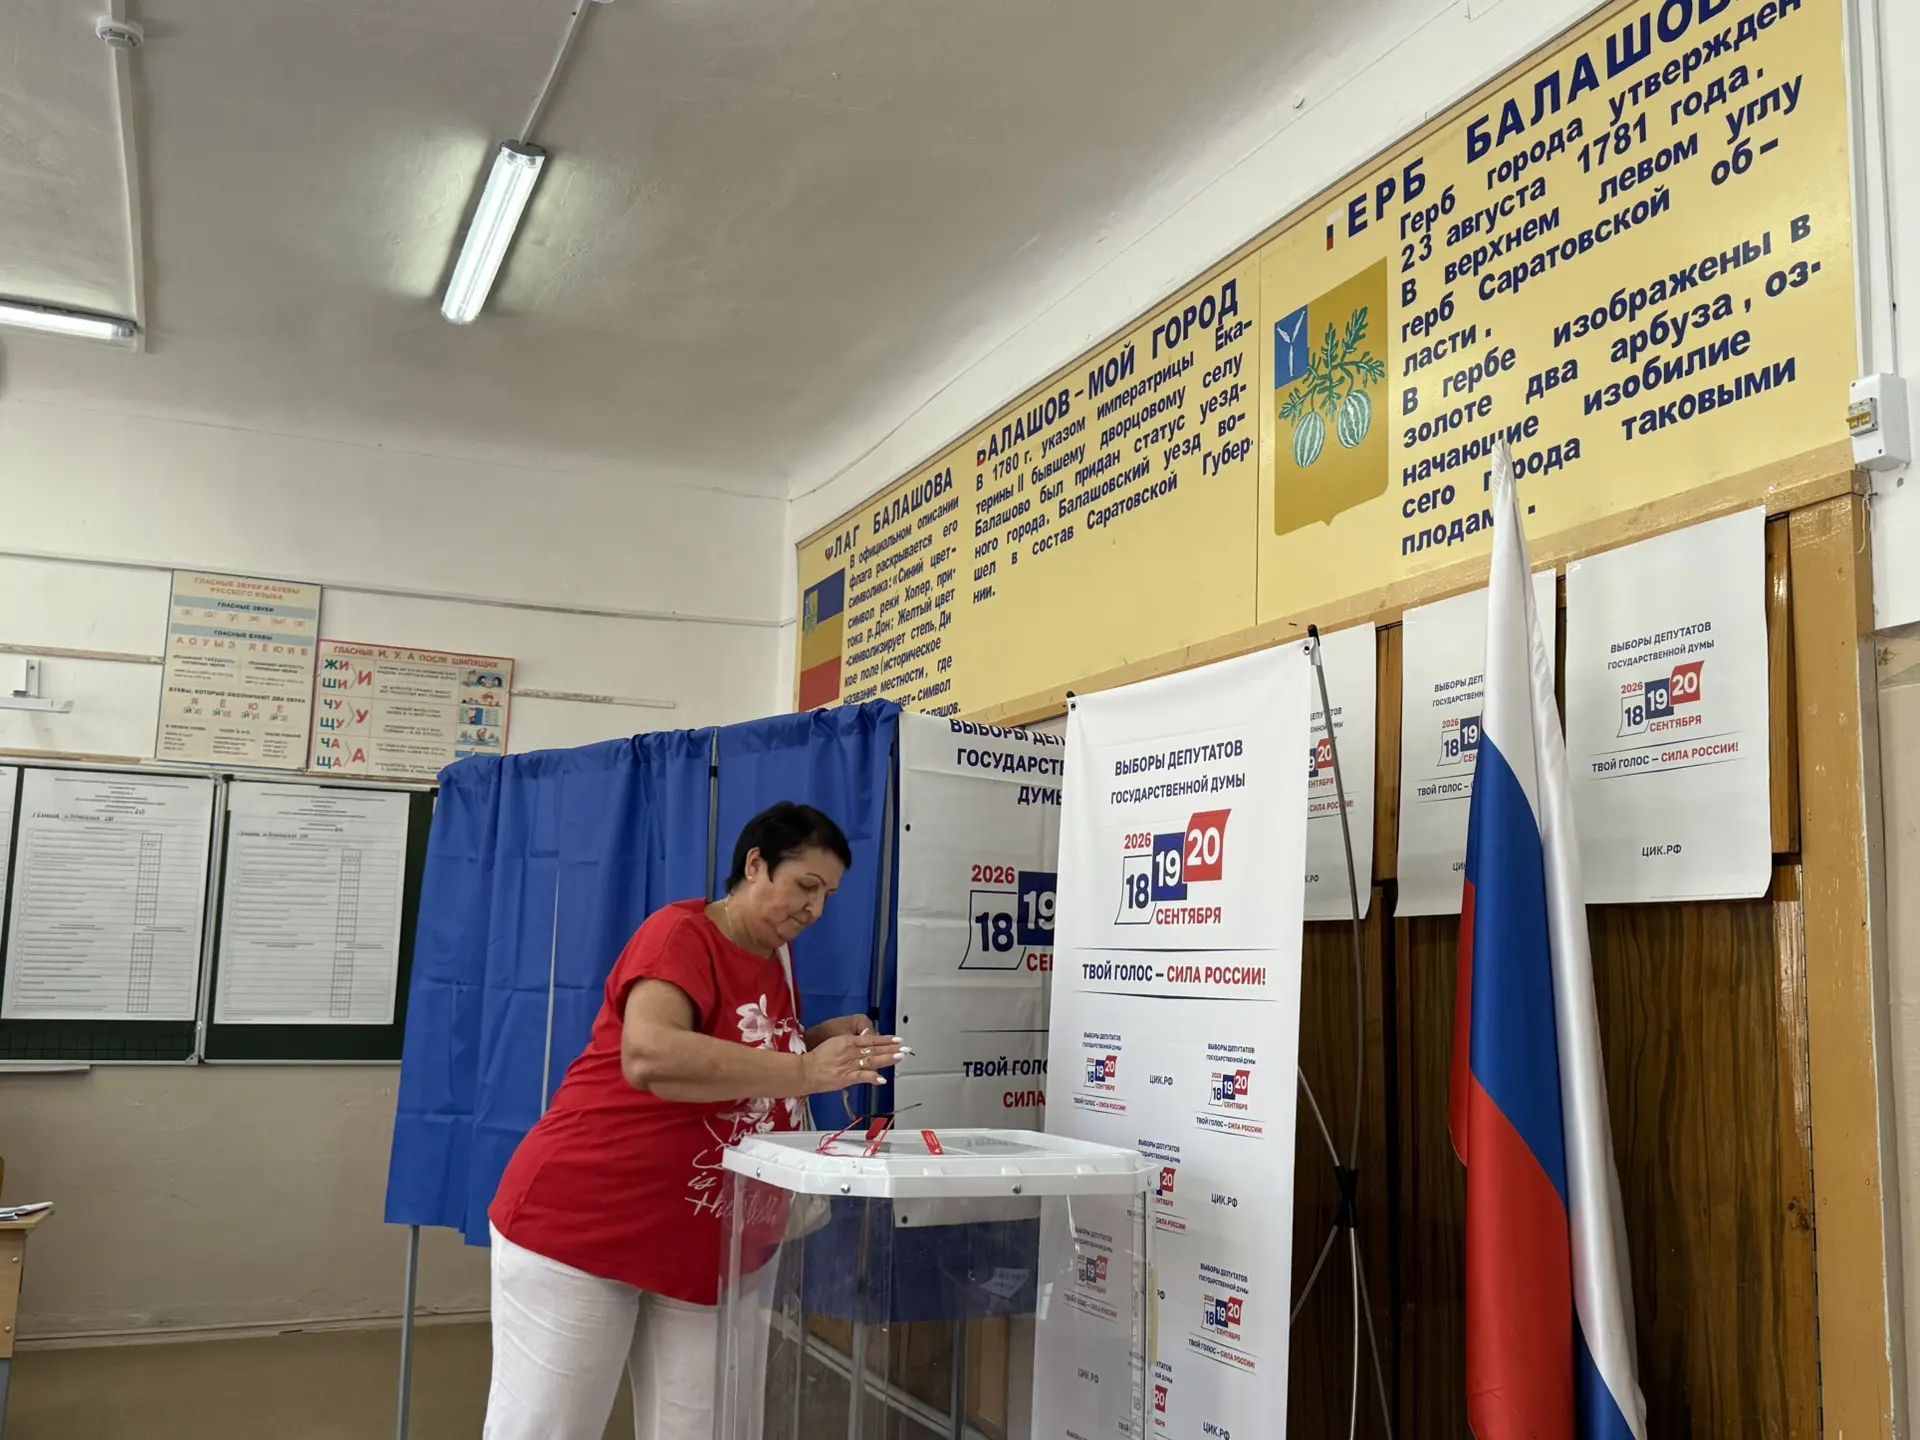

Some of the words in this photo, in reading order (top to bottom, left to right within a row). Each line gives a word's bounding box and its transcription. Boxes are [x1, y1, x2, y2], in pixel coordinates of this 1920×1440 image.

[1400, 184, 1456, 240] Герб
[1487, 117, 1584, 190] города
[1609, 0, 1801, 127] утвержден
[1401, 233, 1432, 273] 23
[1446, 176, 1546, 246] августа
[1577, 112, 1647, 173] 1781
[1445, 207, 1560, 284] верхнем
[1598, 132, 1698, 204] левом
[1725, 74, 1803, 145] углу
[1402, 291, 1454, 343] герб
[1478, 184, 1670, 301] Саратовской
[1443, 346, 1516, 397] гербе
[1553, 232, 1772, 347] изображены
[1088, 341, 1135, 400] МОЙ
[1152, 278, 1238, 360] ГОРОД
[1584, 329, 1750, 416] изобилие
[992, 452, 1019, 481] 1780
[1024, 449, 1032, 464] г.
[1041, 416, 1085, 459] указом
[1097, 350, 1194, 420] императрицы
[1403, 394, 1493, 448] золоте
[1525, 359, 1579, 404] два
[975, 483, 1014, 515] терины
[1031, 443, 1085, 486] бывшему
[1100, 386, 1185, 450] дворцовому
[1202, 352, 1243, 388] селу
[1402, 484, 1455, 518] сего
[1484, 438, 1581, 492] грода
[1621, 357, 1795, 440] таковыми
[975, 499, 1030, 538] Балашово
[1040, 480, 1063, 504] был
[1075, 449, 1120, 487] придан
[1134, 414, 1185, 453] статус
[873, 467, 952, 534] БАЛАШОВА
[974, 537, 998, 559] ного
[1007, 515, 1050, 544] города.
[1058, 457, 1149, 519] Балашовский
[1163, 433, 1201, 470] уезд
[943, 520, 958, 538] его
[973, 560, 996, 582] шел
[1032, 525, 1074, 555] состав
[1087, 470, 1177, 530] Саратовской
[973, 585, 995, 604] нии.
[1610, 635, 1652, 653] ВЫБОРЫ
[1654, 621, 1711, 645] ДЕПУТАТОВ
[1608, 643, 1686, 670] ГОСУДАРСТВЕННОЙ
[1688, 640, 1715, 654] ДУМЫ
[1433, 690, 1484, 707] ГОСУДАРСТВЕНН
[1434, 679, 1466, 692] ВЫБОРЫ
[1621, 682, 1643, 694] 2026
[1647, 689, 1668, 711] 19
[1672, 672, 1698, 697] 20
[1442, 718, 1459, 728] 2026
[1624, 705, 1643, 727] 18
[1650, 714, 1702, 732] СЕНТЯБРЯ
[1444, 739, 1459, 757] 18
[1462, 725, 1478, 744] 19
[1115, 752, 1165, 776] ВЫБОРЫ
[1168, 739, 1243, 770] ДЕПУТАТОВ
[1592, 758, 1617, 773] ТВОЙ
[1619, 756, 1649, 769] ГОЛОС
[1661, 747, 1688, 762] СИЛА
[1692, 742, 1738, 758] РОССИИ!
[1111, 775, 1208, 804] ГОСУДАРСТВЕННОЙ
[1210, 773, 1245, 794] ДУМЫ
[1418, 784, 1437, 796] ТВОЙ
[1438, 782, 1462, 795] ГОЛОС
[1124, 832, 1151, 849] 2026
[1186, 826, 1221, 866] 20
[1642, 844, 1681, 857] ЦИК.РФ
[971, 864, 1016, 884] 2026
[1156, 849, 1181, 887] 19
[1126, 873, 1149, 909] 18
[1156, 907, 1221, 925] СЕНТЯБРЯ
[975, 912, 1015, 952] 18
[1082, 960, 1112, 981] ТВОЙ
[1114, 964, 1153, 982] ГОЛОС
[1167, 965, 1201, 983] СИЛА
[1204, 967, 1266, 986] РОССИИ!
[963, 1056, 1008, 1077] ТВОЙ
[1003, 1090, 1045, 1108] СИЛА
